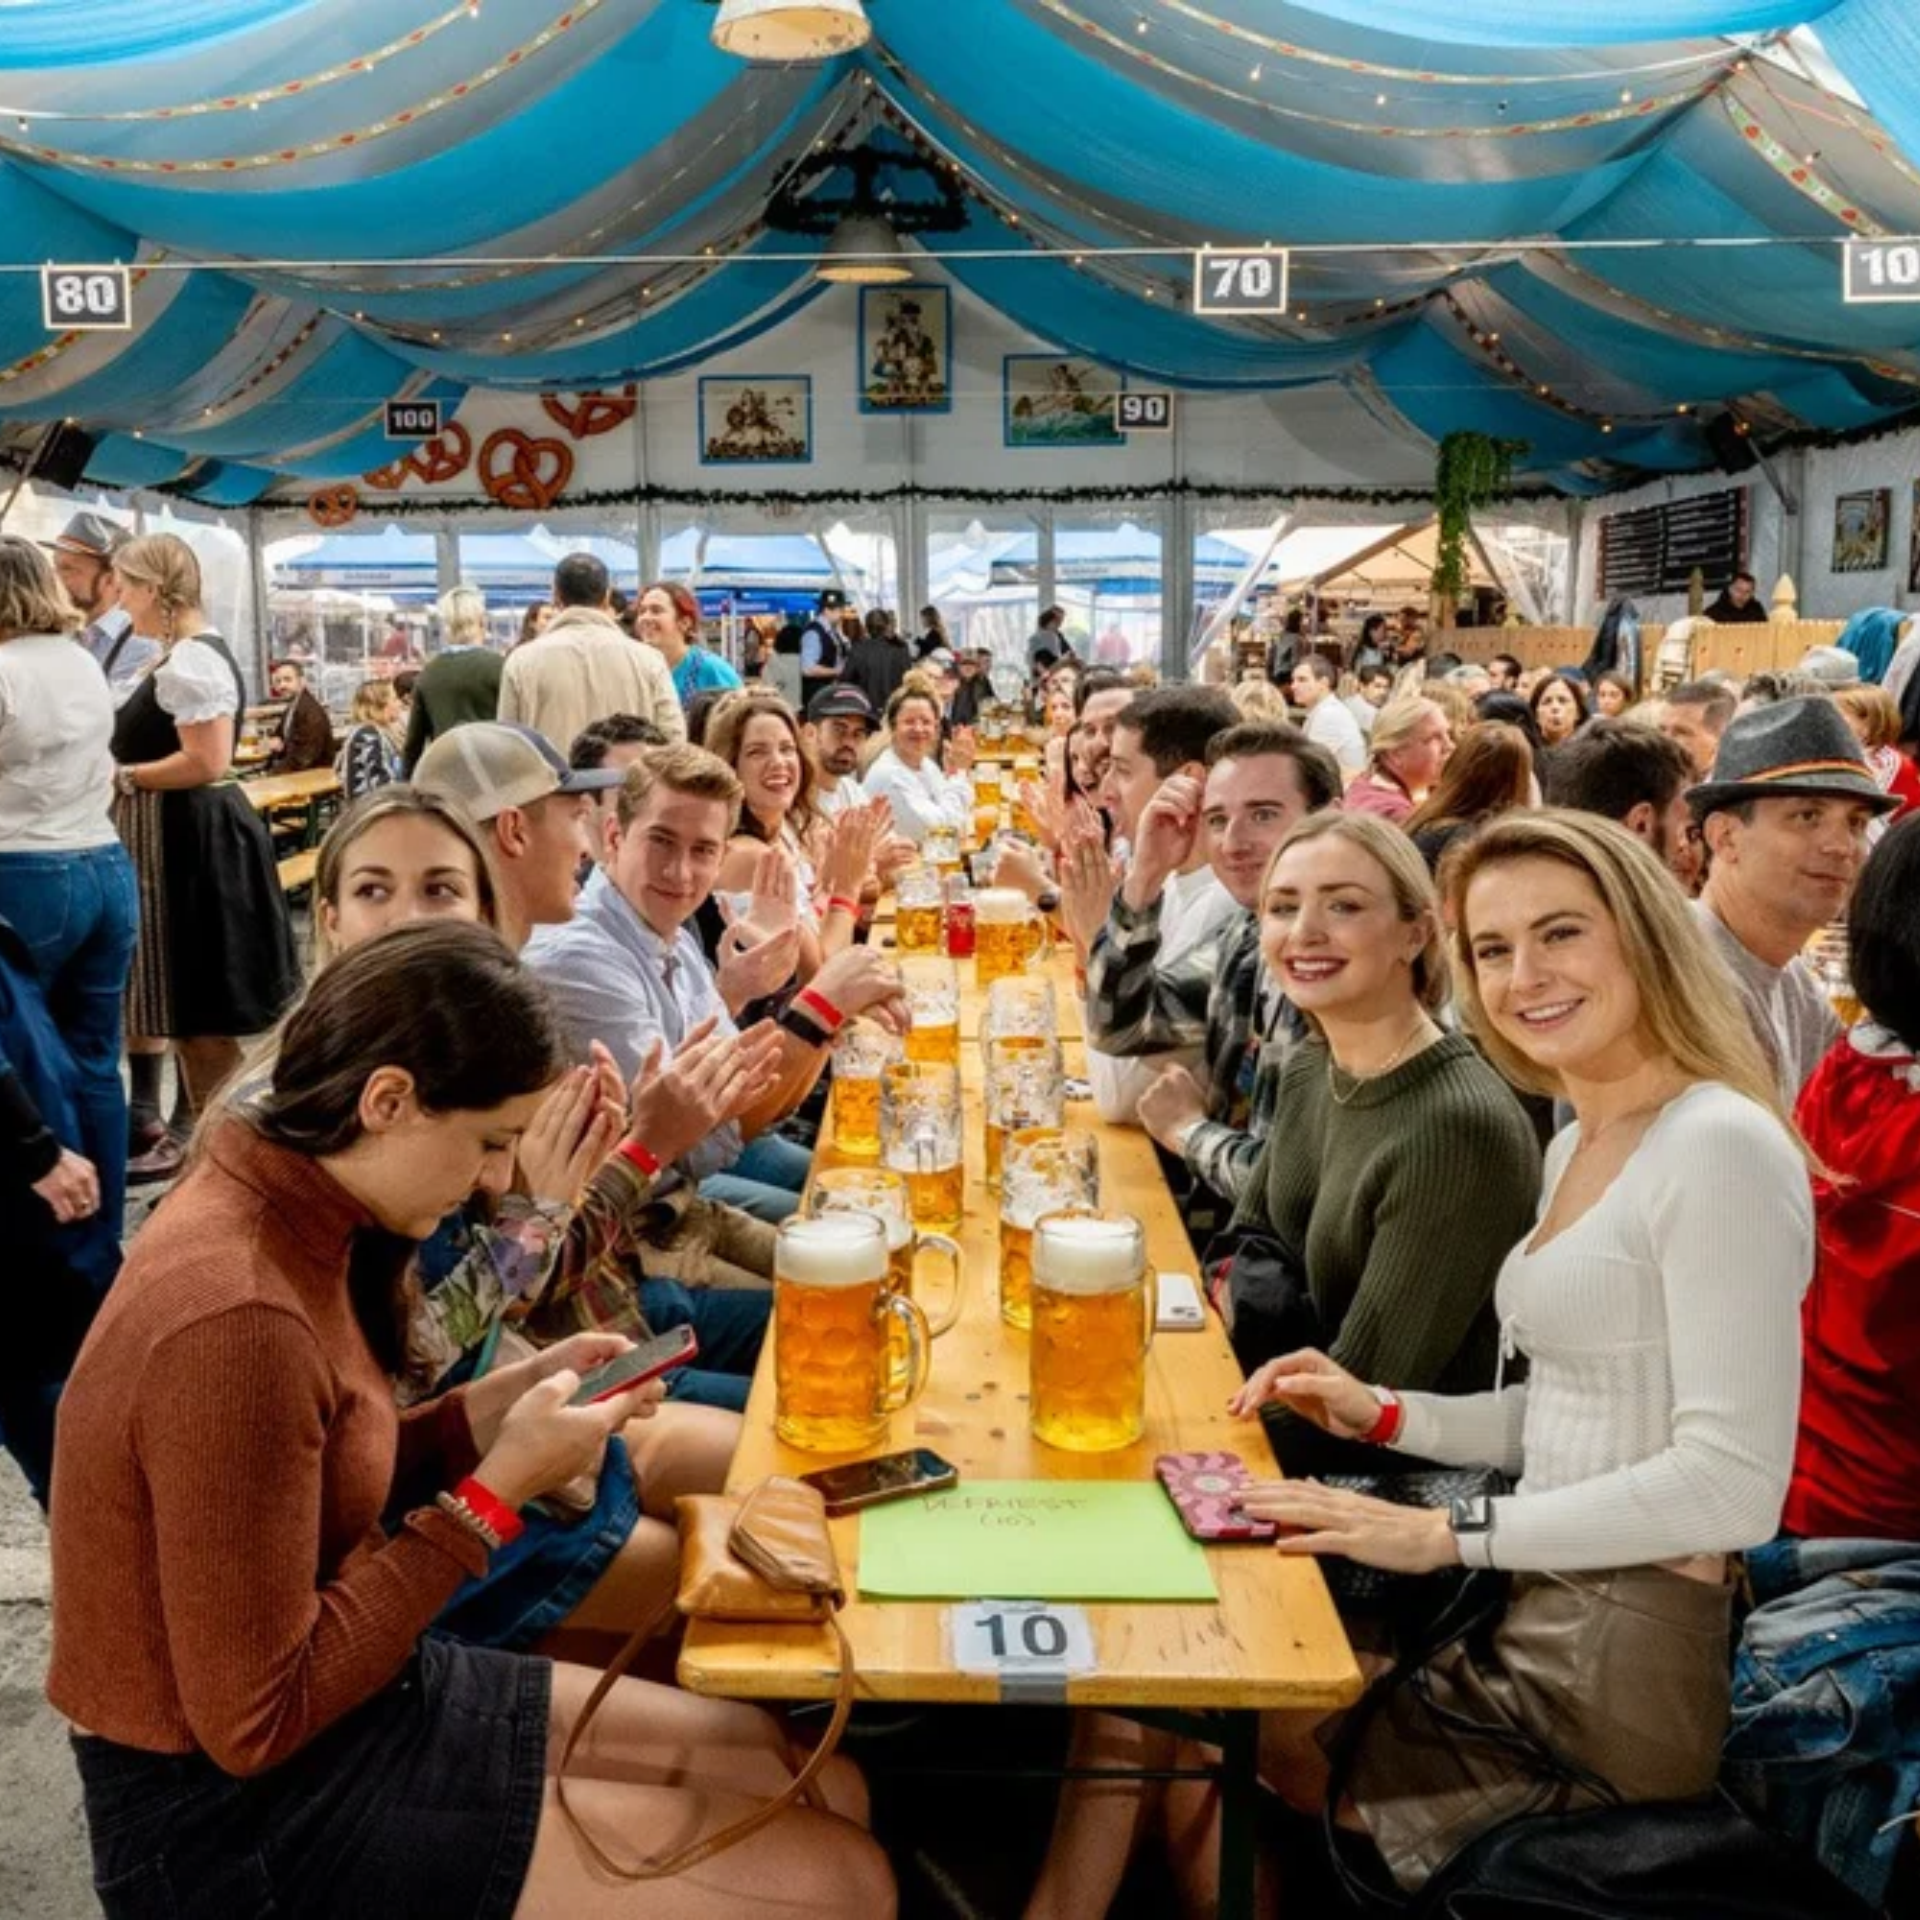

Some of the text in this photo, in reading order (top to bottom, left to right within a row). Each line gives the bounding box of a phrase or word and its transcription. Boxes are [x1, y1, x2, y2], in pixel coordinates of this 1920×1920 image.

[55, 275, 116, 315] 80
[1209, 258, 1272, 298] 70
[392, 409, 435, 429] 100
[1123, 396, 1166, 421] 90
[974, 1614, 1068, 1656] 10
